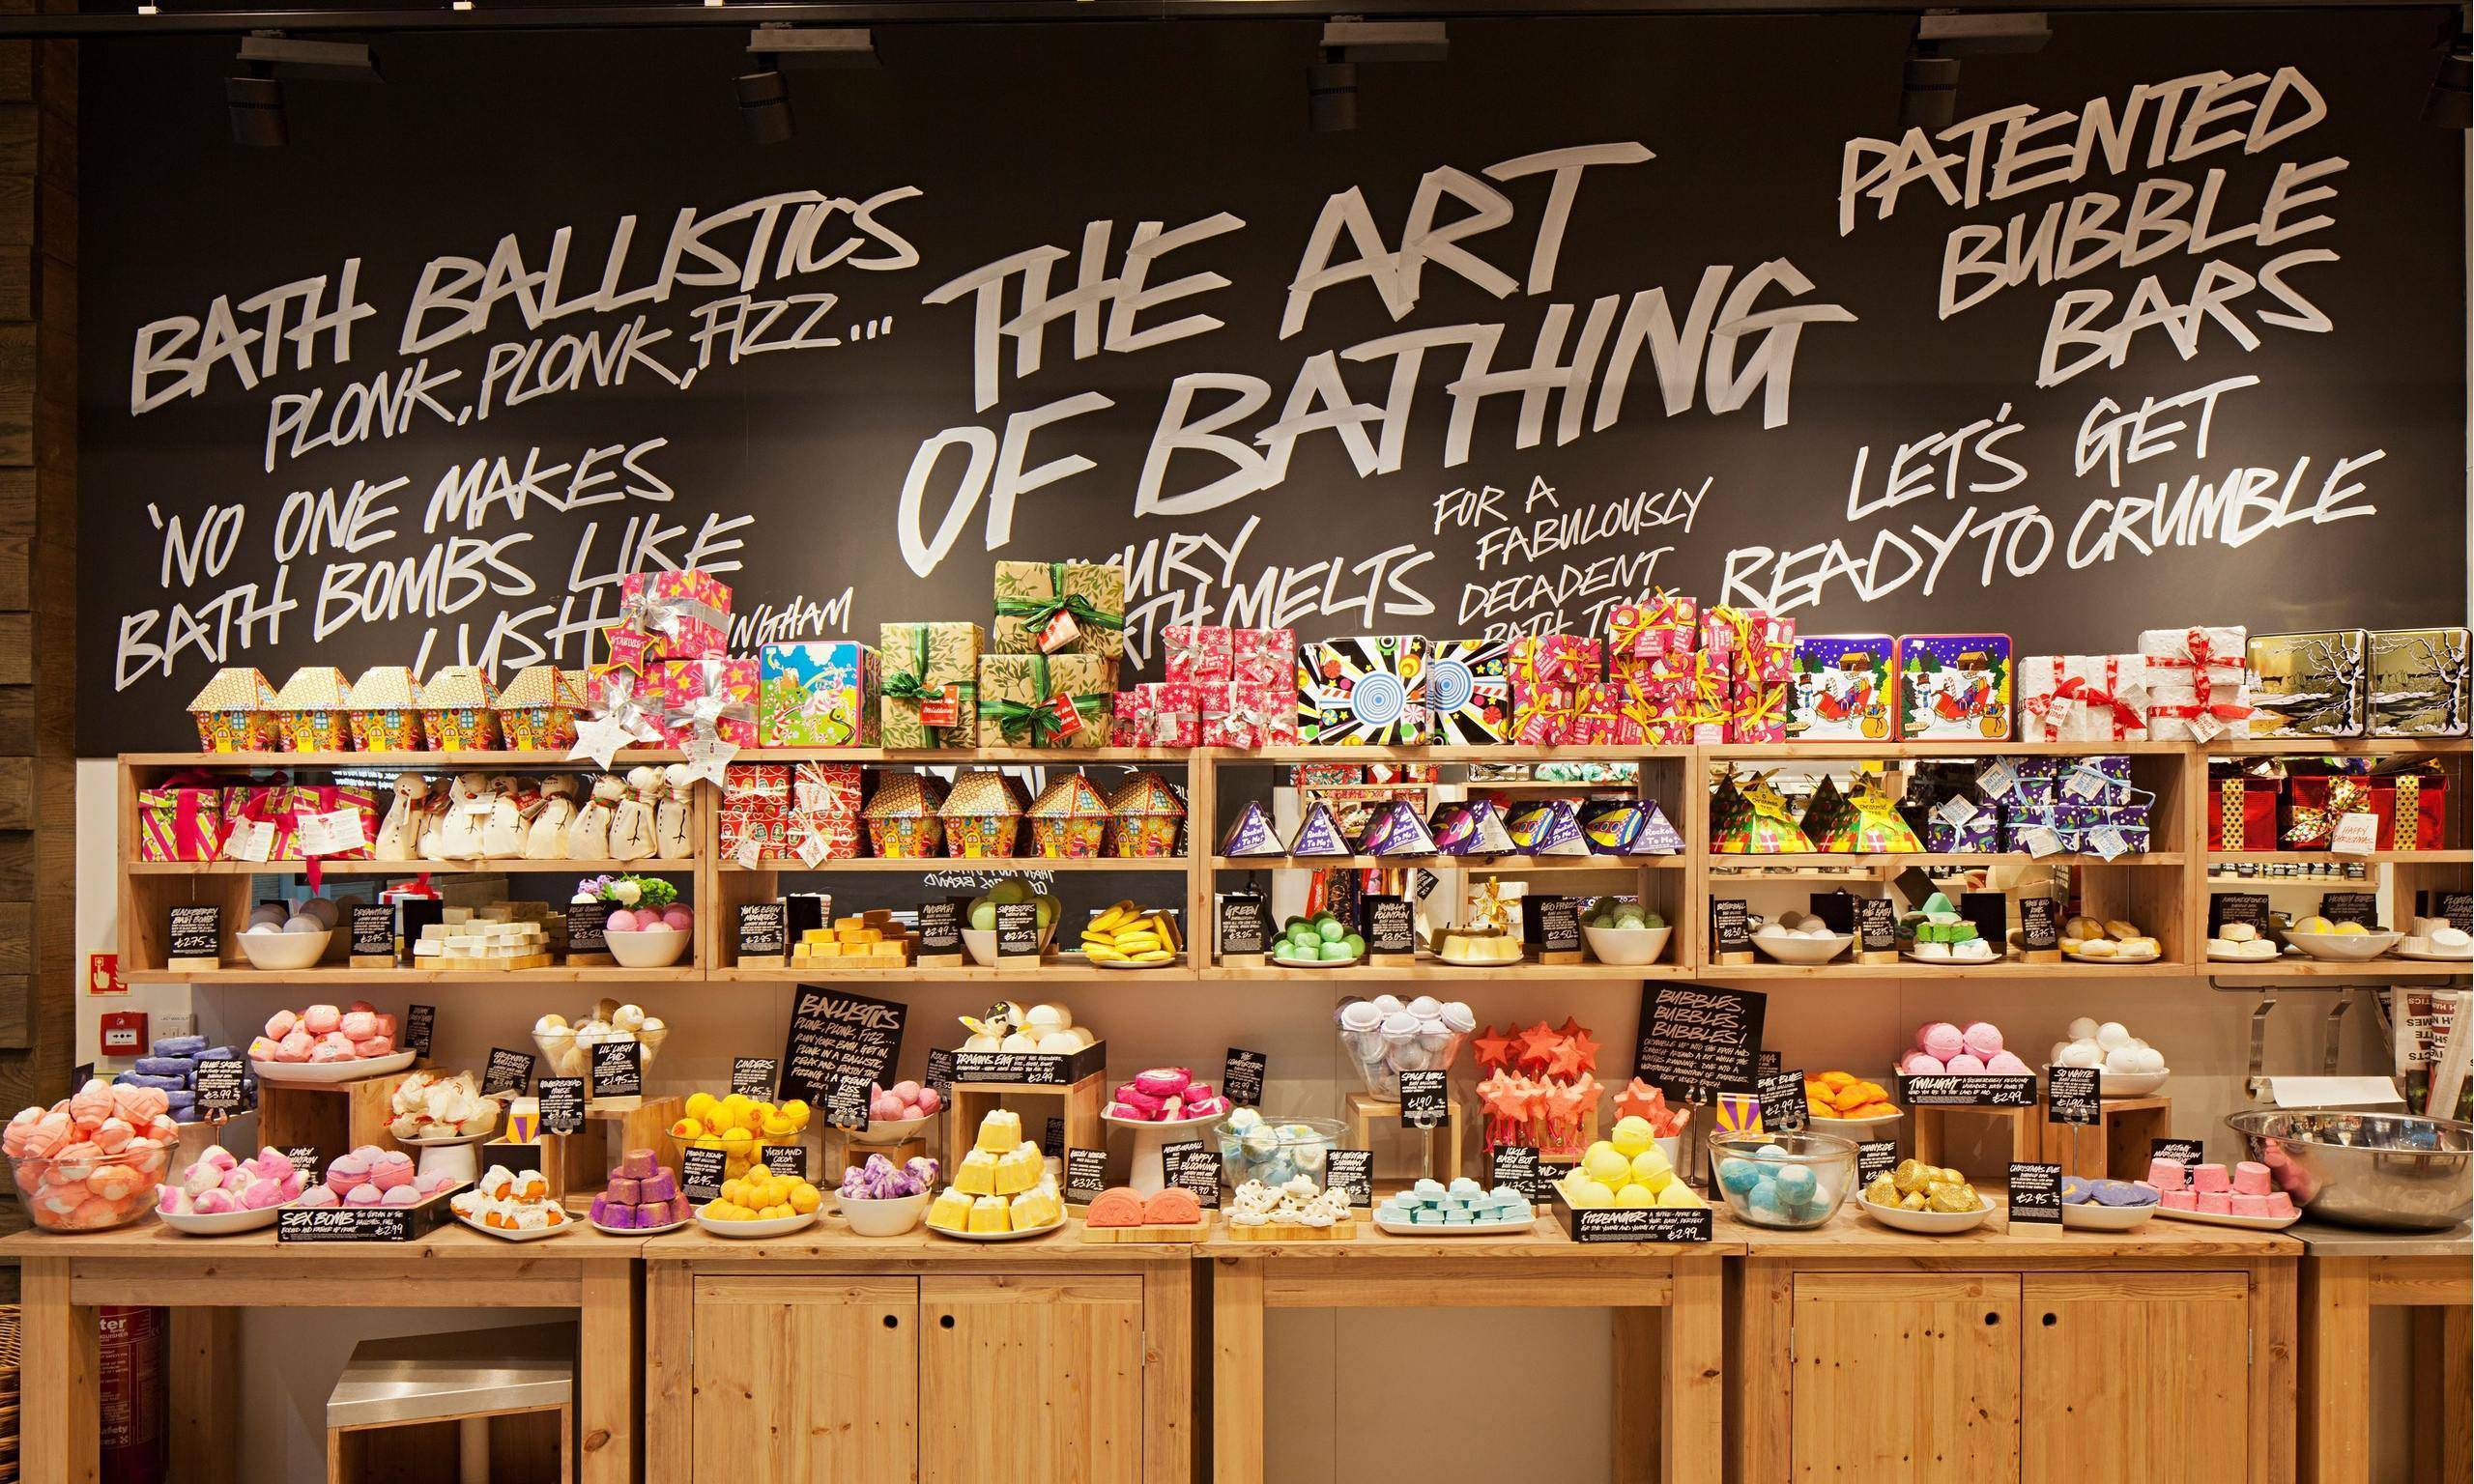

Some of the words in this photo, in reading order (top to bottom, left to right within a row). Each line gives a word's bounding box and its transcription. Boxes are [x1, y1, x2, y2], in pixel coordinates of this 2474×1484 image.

[1839, 65, 2328, 239] PATENTED
[1938, 156, 2350, 321] BUBBLE
[921, 211, 1248, 414] THE
[1280, 140, 1657, 342] ART
[131, 257, 376, 416] BATH
[399, 186, 924, 355] BALLISTICS
[2035, 248, 2341, 388] BARS
[265, 358, 473, 472] PLONK,
[897, 390, 1116, 579] OF
[1134, 257, 1857, 520] BATHING
[1847, 402, 2028, 522] LET'S
[2076, 375, 2261, 487] GET
[274, 474, 411, 563] ONE
[425, 437, 676, 534] MAKES
[1432, 484, 1506, 537] FOR
[1525, 475, 1559, 516] A
[1476, 476, 1713, 572] FABULOUSLY
[1719, 506, 1977, 618] READY
[1971, 504, 2054, 586] TO
[2066, 448, 2387, 562] CRUMBLE
[1222, 543, 1436, 634] MELTS
[1458, 546, 1676, 625] DECADENT
[115, 565, 300, 693] BATH
[315, 531, 535, 643] BOMBS
[570, 512, 757, 594] LIKE
[611, 635, 647, 649] STARDUST
[1242, 828, 1263, 839] Rocket
[1307, 829, 1329, 840] Rocket
[1395, 826, 1415, 838] Rocket
[1553, 822, 1573, 835] Rocket
[1646, 827, 1674, 837] Rocket
[2343, 826, 2368, 835] HAPPY
[1225, 904, 1259, 918] GREEN
[1655, 989, 1746, 1014] BUBBLES,
[798, 993, 900, 1030] BALLISTICS
[1654, 1005, 1746, 1030] BUBBLES,
[793, 1016, 828, 1033] PLONK,
[824, 1022, 856, 1041] PLONK,
[1652, 1021, 1747, 1048] BUBBLES!
[612, 1043, 635, 1053] LUSH
[794, 1033, 816, 1044] RUN
[815, 1035, 837, 1047] YOUR
[860, 1043, 877, 1055] GET
[1704, 1044, 1717, 1053] THE
[1717, 1046, 1734, 1055] BATH
[1734, 1048, 1750, 1057] AND
[795, 1044, 821, 1056] PLONK
[821, 1049, 833, 1059] IN
[831, 1052, 840, 1061] A
[930, 1051, 949, 1062] ROSE
[735, 1059, 775, 1070] CINDERS
[792, 1056, 819, 1067] RELAX
[818, 1060, 837, 1070] AND
[837, 1064, 865, 1076] ENJOY
[864, 1069, 880, 1079] THE
[1673, 1067, 1704, 1077] MOUNTAIN
[1401, 1071, 1424, 1081] SPACE
[1779, 1071, 1803, 1083] BLUE
[2054, 1069, 2067, 1077] SO
[2067, 1070, 2095, 1078] WHITE
[838, 1082, 860, 1094] KISS
[1909, 1076, 1963, 1091] TWILIGHT
[289, 1148, 315, 1156] CANDY
[1506, 1147, 1528, 1156] ICKLE
[1859, 1143, 1895, 1153] SUNNYSIDE
[1189, 1153, 1214, 1163] HAPPY
[2010, 1164, 2046, 1174] CHRISTMAS
[2045, 1166, 2060, 1175] EVE
[280, 1212, 314, 1226] SEX
[314, 1211, 356, 1226] BOMB
[1580, 1211, 1648, 1225] FIZZBANGER
